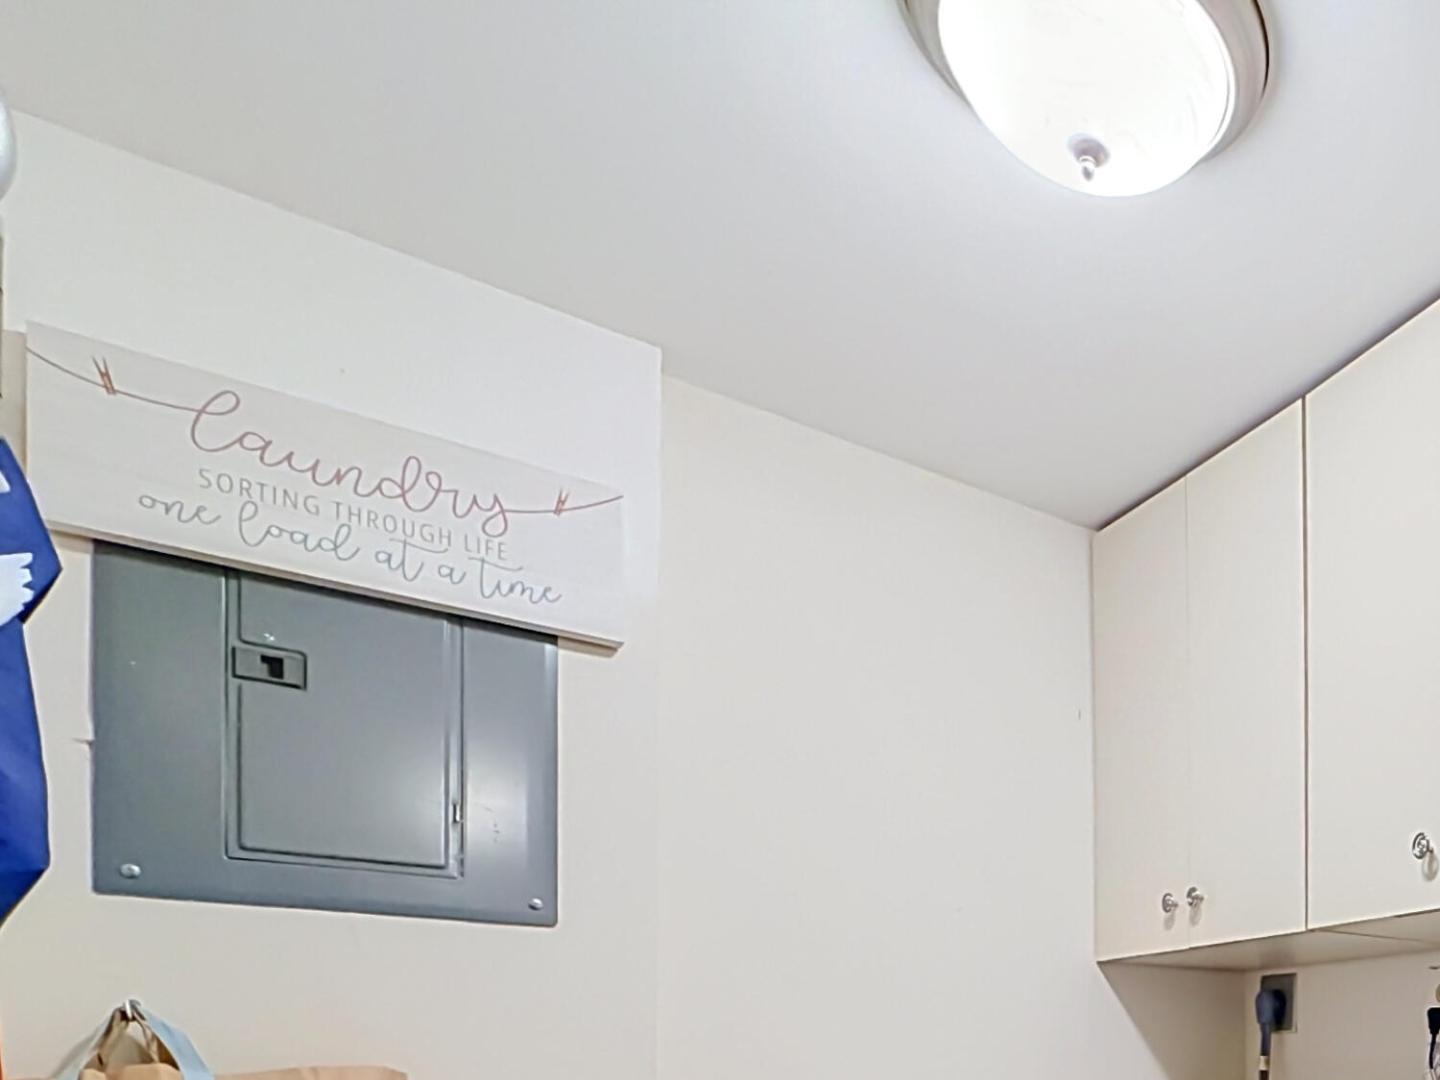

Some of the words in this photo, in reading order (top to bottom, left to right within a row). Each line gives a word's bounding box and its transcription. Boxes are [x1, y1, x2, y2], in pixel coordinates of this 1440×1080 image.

[138, 494, 222, 526] one
[238, 500, 361, 562] load
[375, 537, 449, 582] at
[437, 564, 467, 585] a
[467, 556, 563, 604] time
[198, 468, 320, 517] SORTING
[330, 500, 452, 547] THROUGH
[464, 533, 508, 561] LIFE
